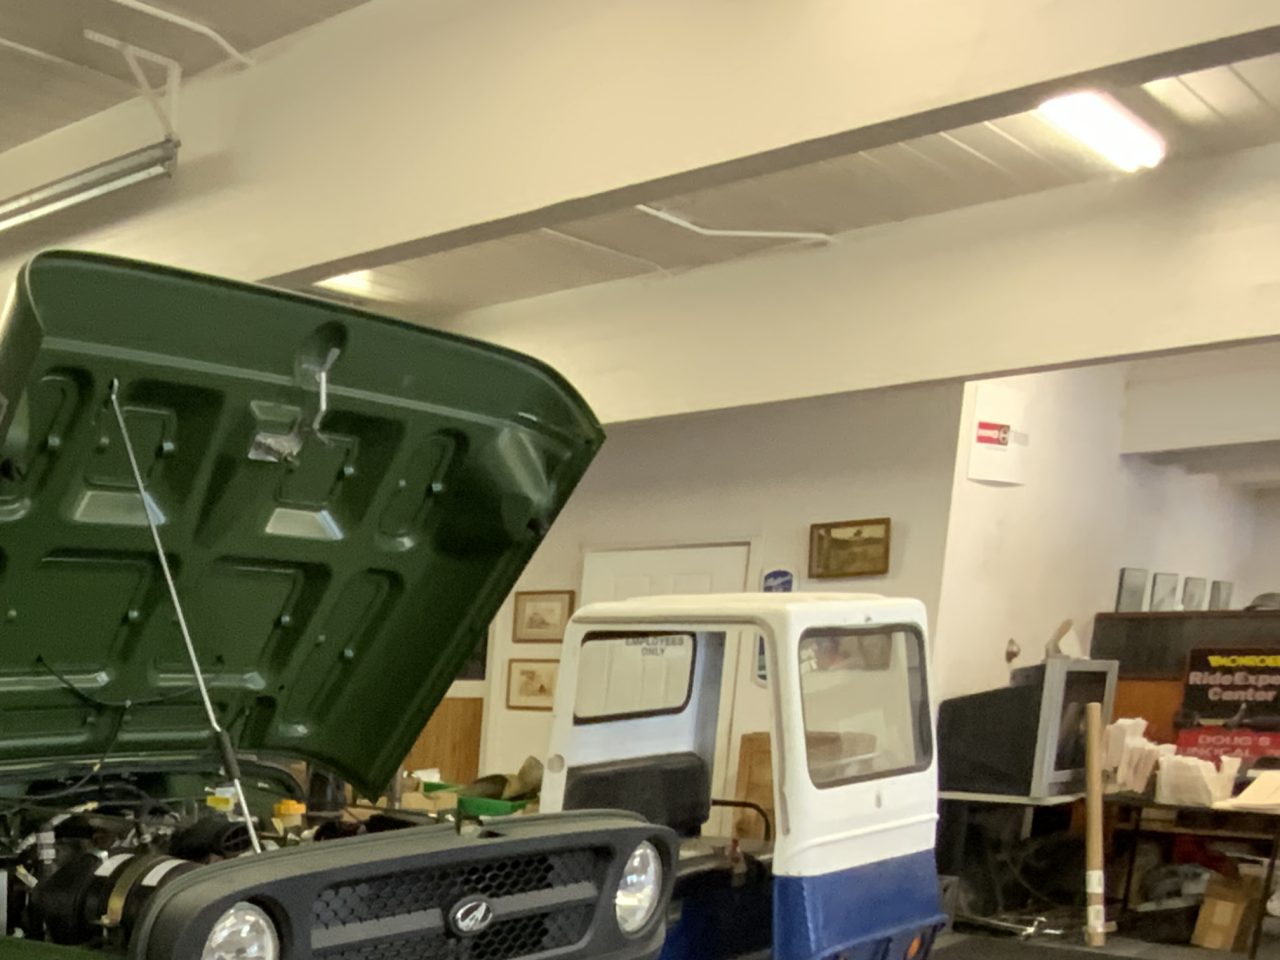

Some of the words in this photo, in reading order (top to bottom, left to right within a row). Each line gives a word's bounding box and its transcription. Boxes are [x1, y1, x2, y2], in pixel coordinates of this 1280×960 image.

[625, 635, 684, 646] EMPLOYEES
[641, 647, 665, 656] ONLY
[1208, 687, 1277, 701] Center
